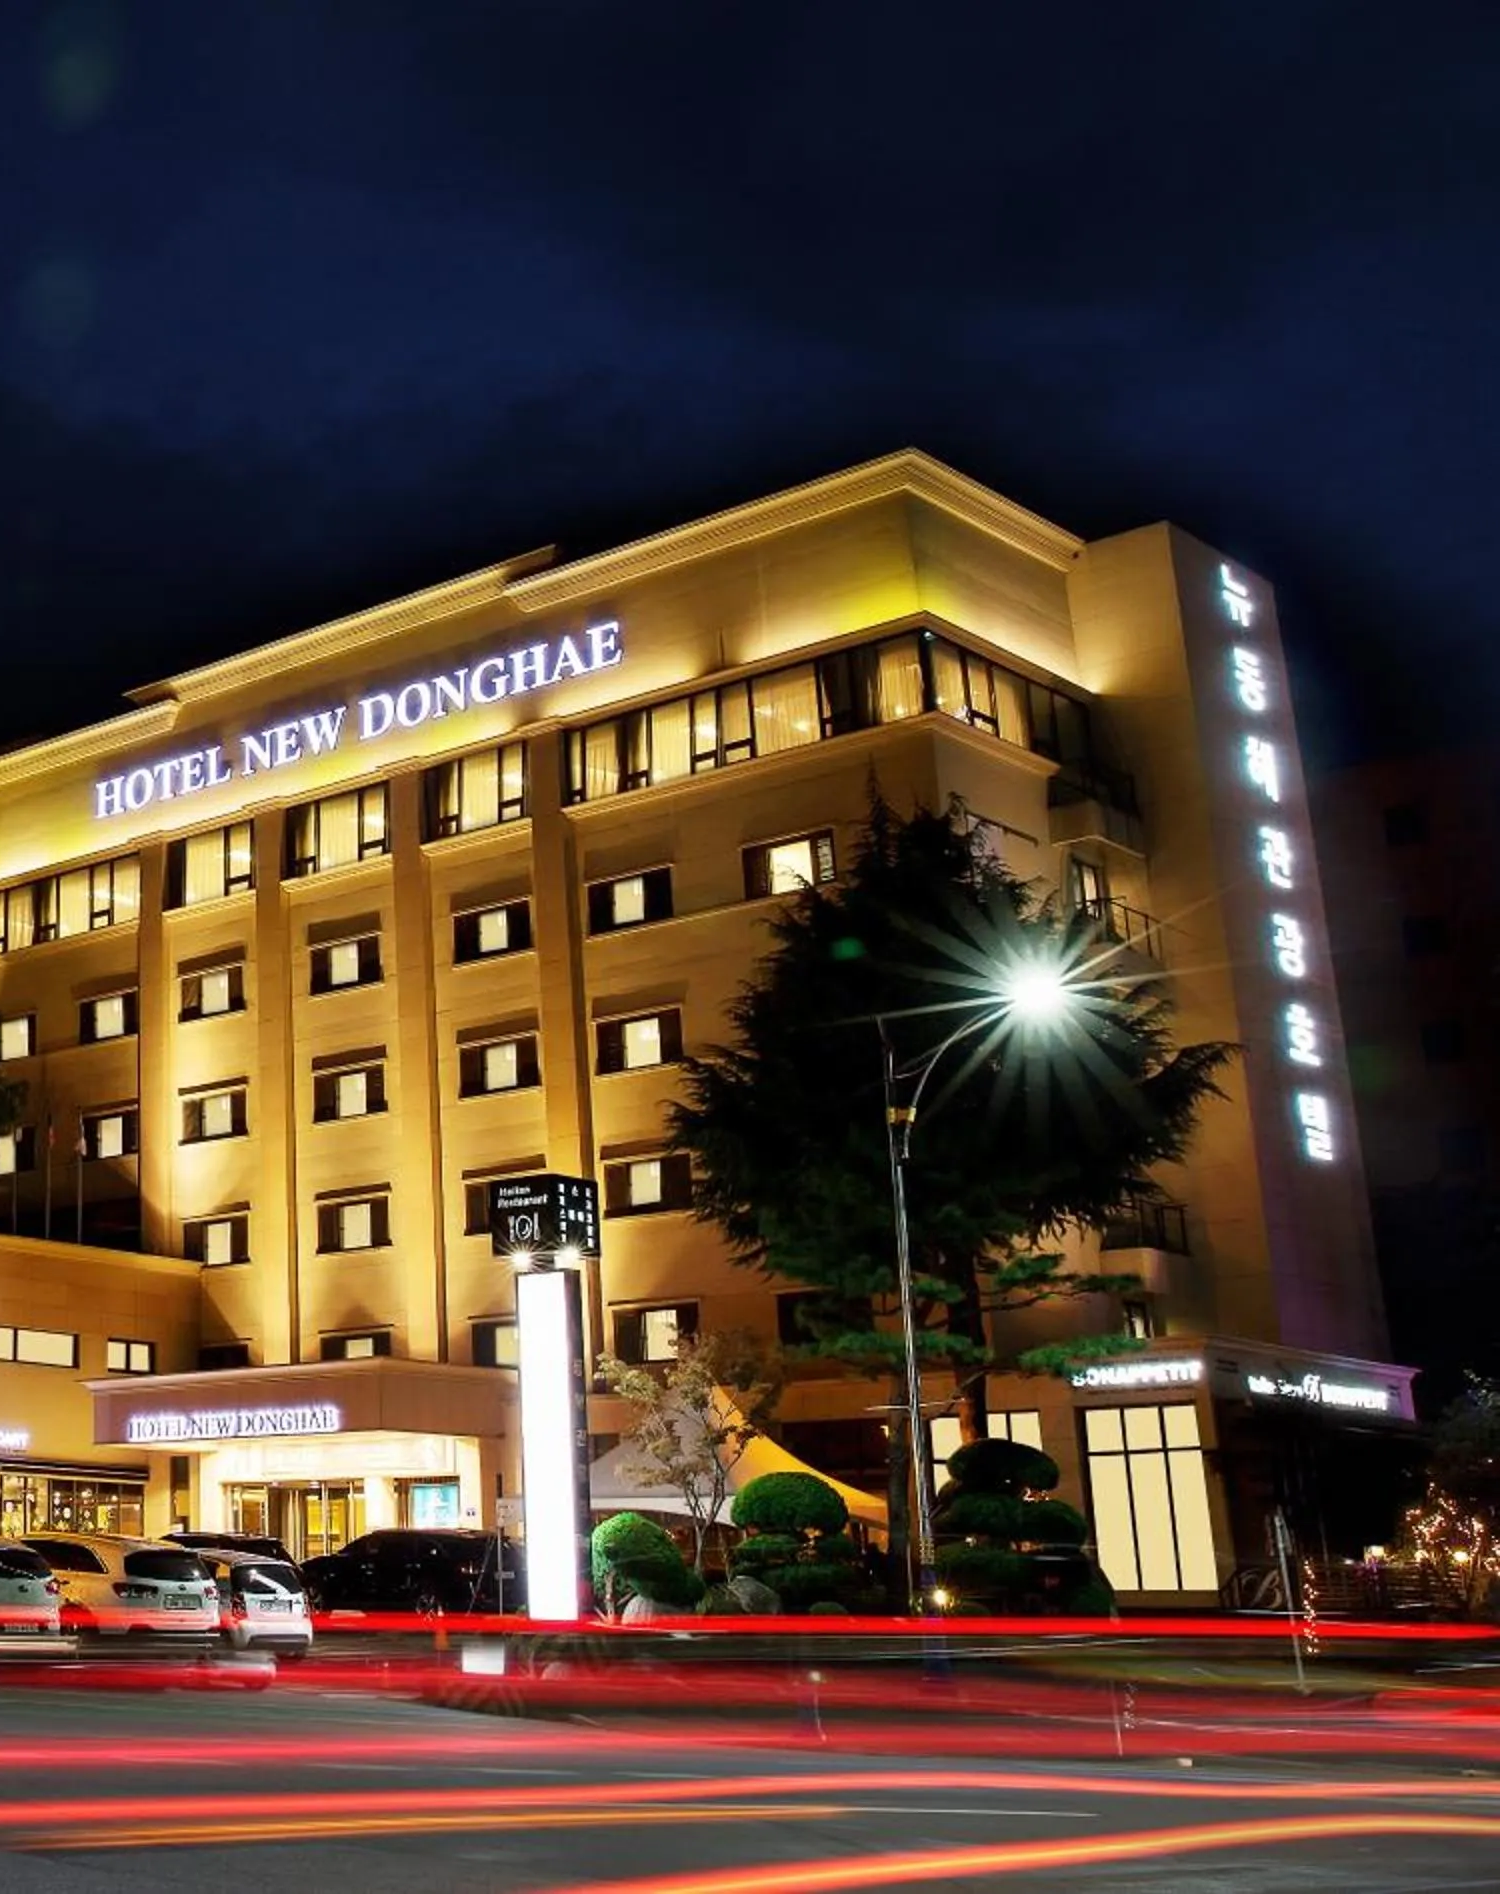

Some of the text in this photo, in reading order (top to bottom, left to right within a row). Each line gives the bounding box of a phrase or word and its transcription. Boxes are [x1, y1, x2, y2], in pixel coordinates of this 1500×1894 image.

[94, 620, 625, 819] HOTEL NEW DONGHAE
[127, 1404, 340, 1441] HOTEL NEW DONGHAE
